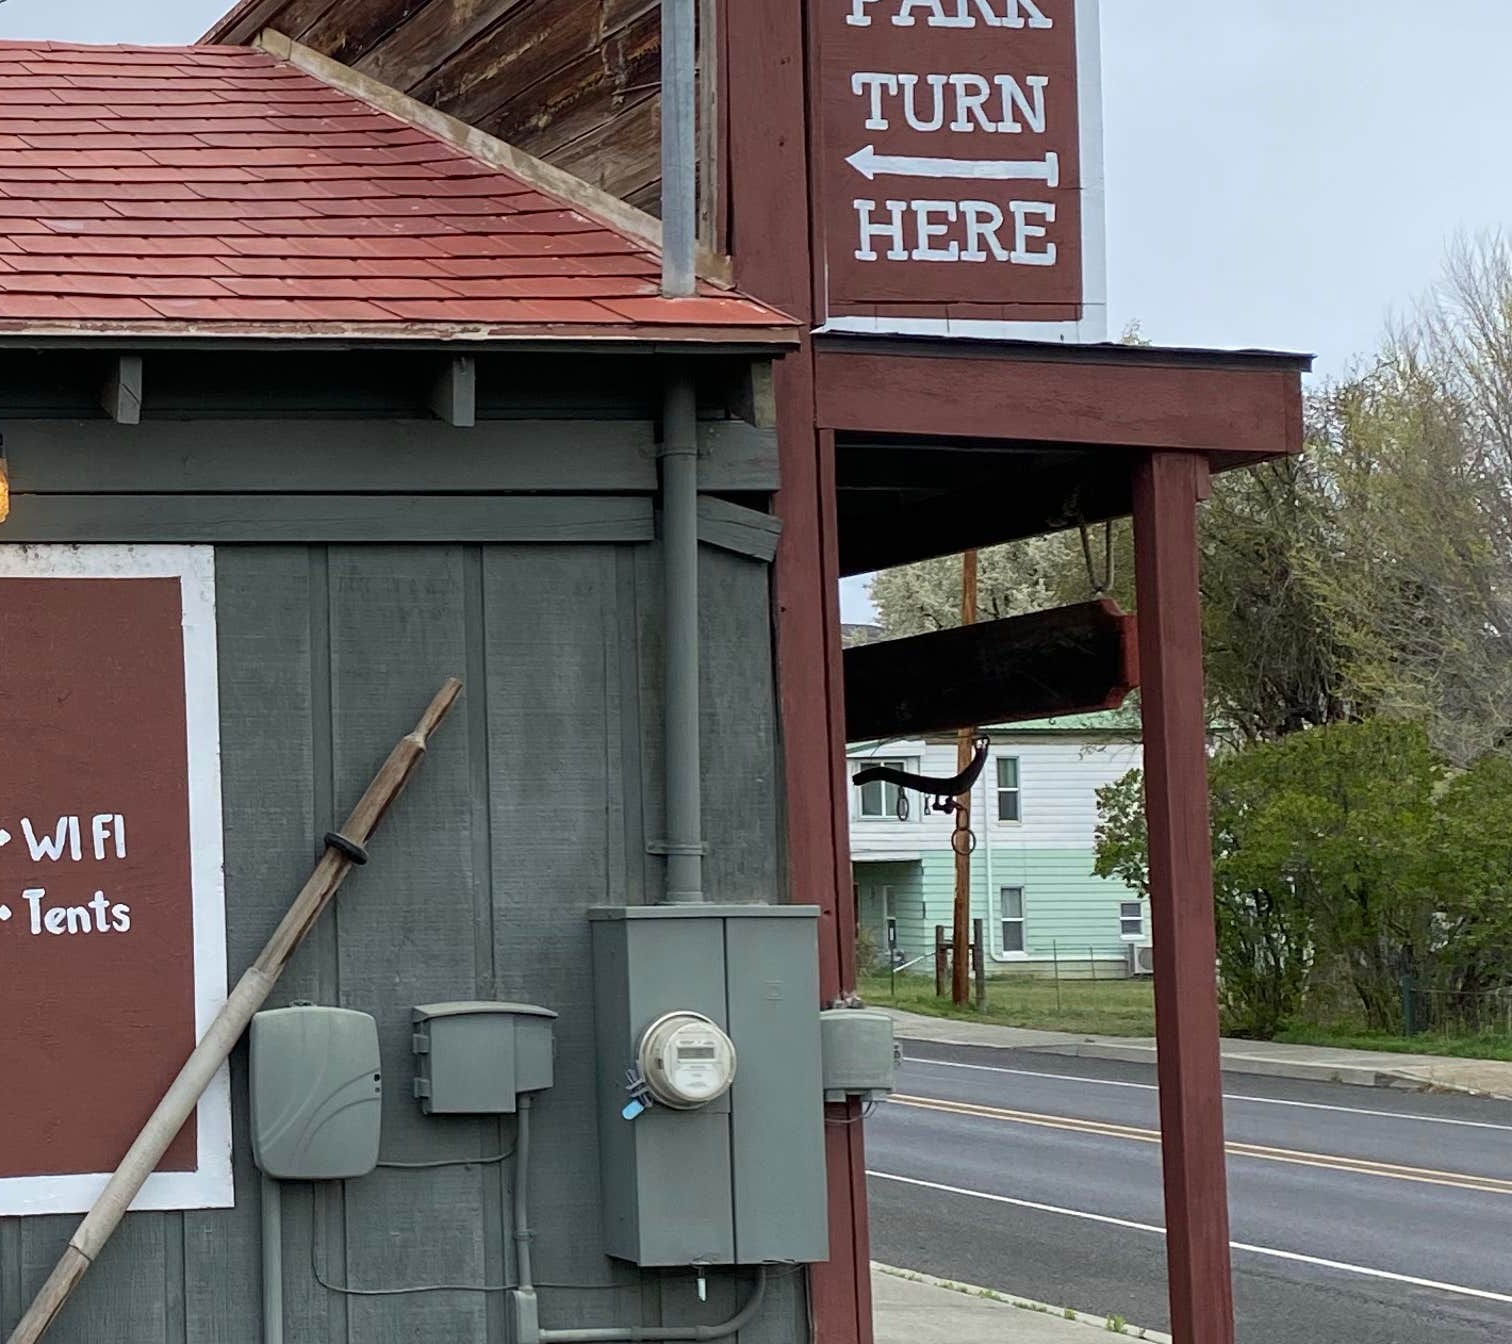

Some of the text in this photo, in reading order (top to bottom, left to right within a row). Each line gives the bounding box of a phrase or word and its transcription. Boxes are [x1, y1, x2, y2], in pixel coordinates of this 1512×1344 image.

[851, 72, 1049, 134] TURN
[853, 198, 1057, 266] HERE
[21, 887, 131, 935] Tents
